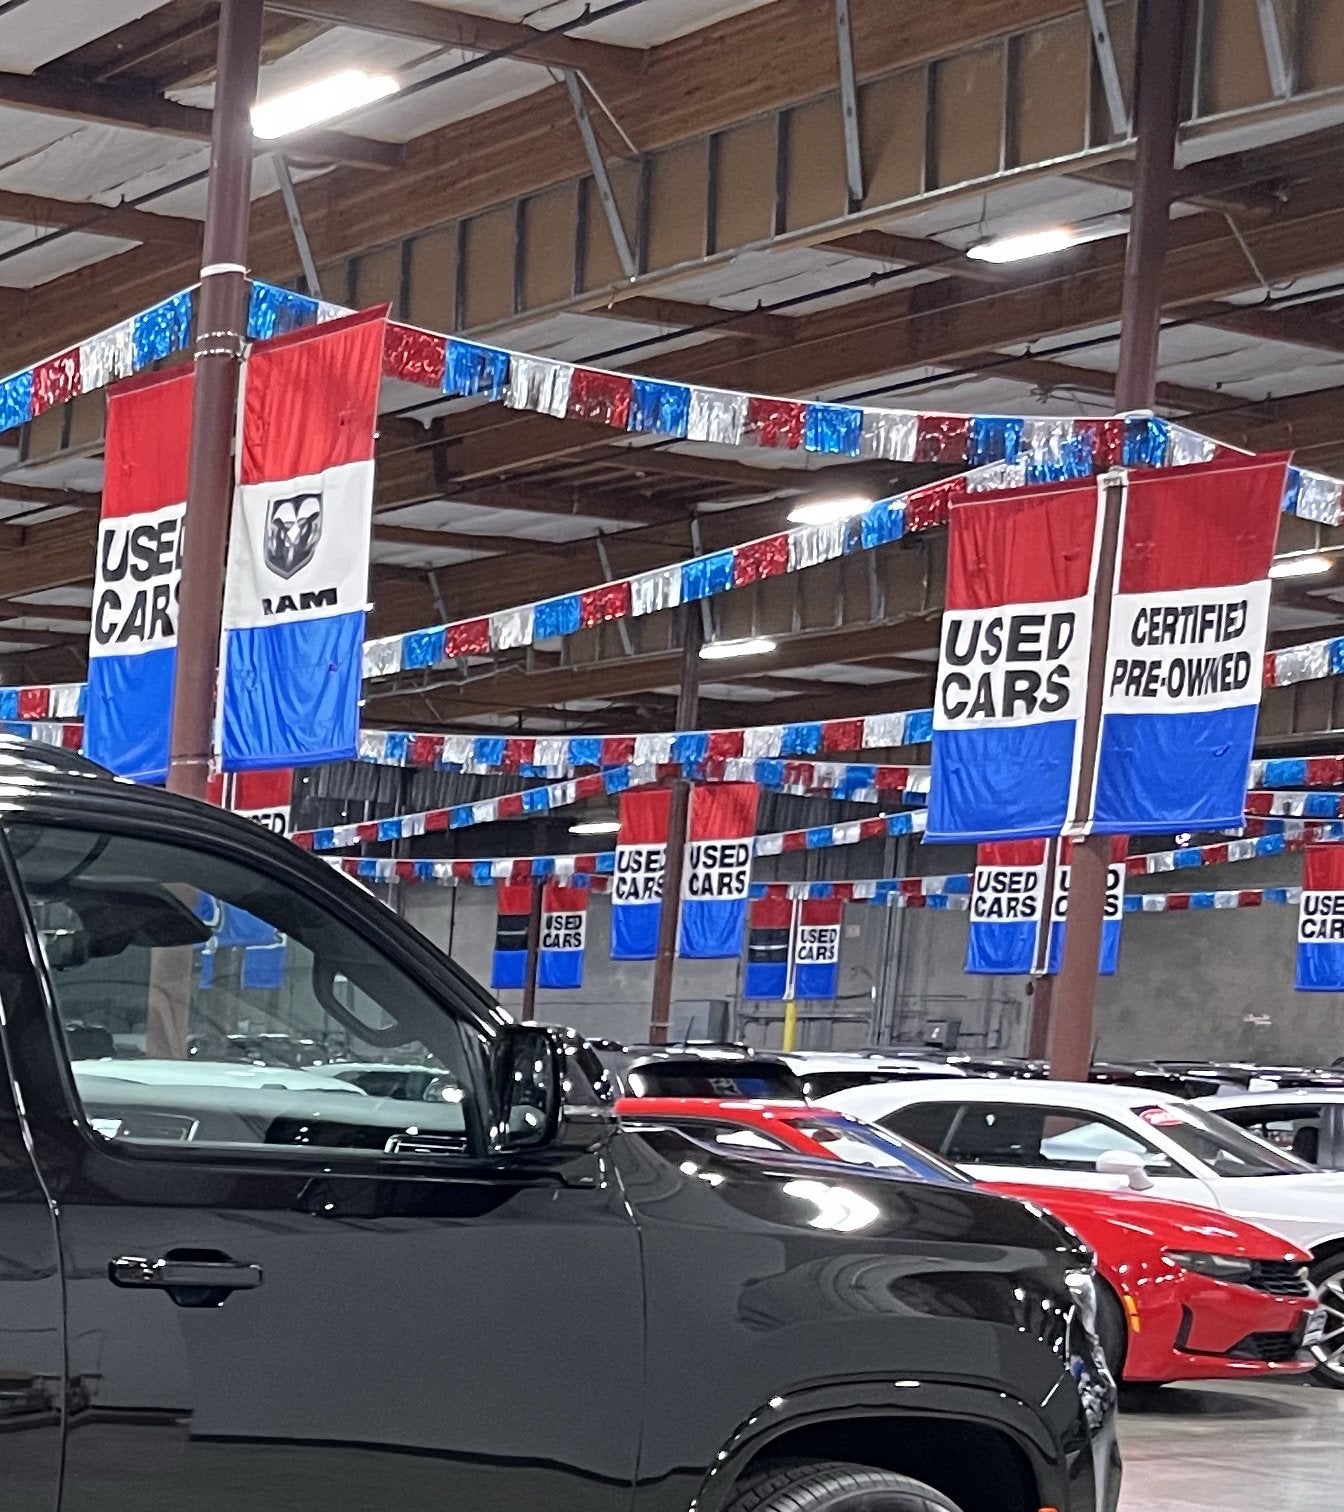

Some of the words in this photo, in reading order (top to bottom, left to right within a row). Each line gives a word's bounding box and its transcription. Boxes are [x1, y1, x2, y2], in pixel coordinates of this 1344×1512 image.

[262, 587, 338, 615] RAM
[95, 583, 181, 645] CAR
[1130, 600, 1247, 648] CERTIFIED
[945, 612, 1076, 667] USED
[1110, 650, 1252, 698] PRE-OWNED
[941, 664, 1072, 720] CARS
[250, 813, 286, 837] ED
[689, 843, 750, 870] USED
[688, 870, 747, 896] CARS
[976, 871, 1039, 894] USED
[1060, 869, 1119, 891] UD
[973, 895, 1038, 918] CARS
[1055, 894, 1118, 916] CS
[546, 915, 582, 931] USED
[543, 932, 582, 948] CARS
[800, 928, 838, 944] USED
[798, 945, 835, 961] CARS
